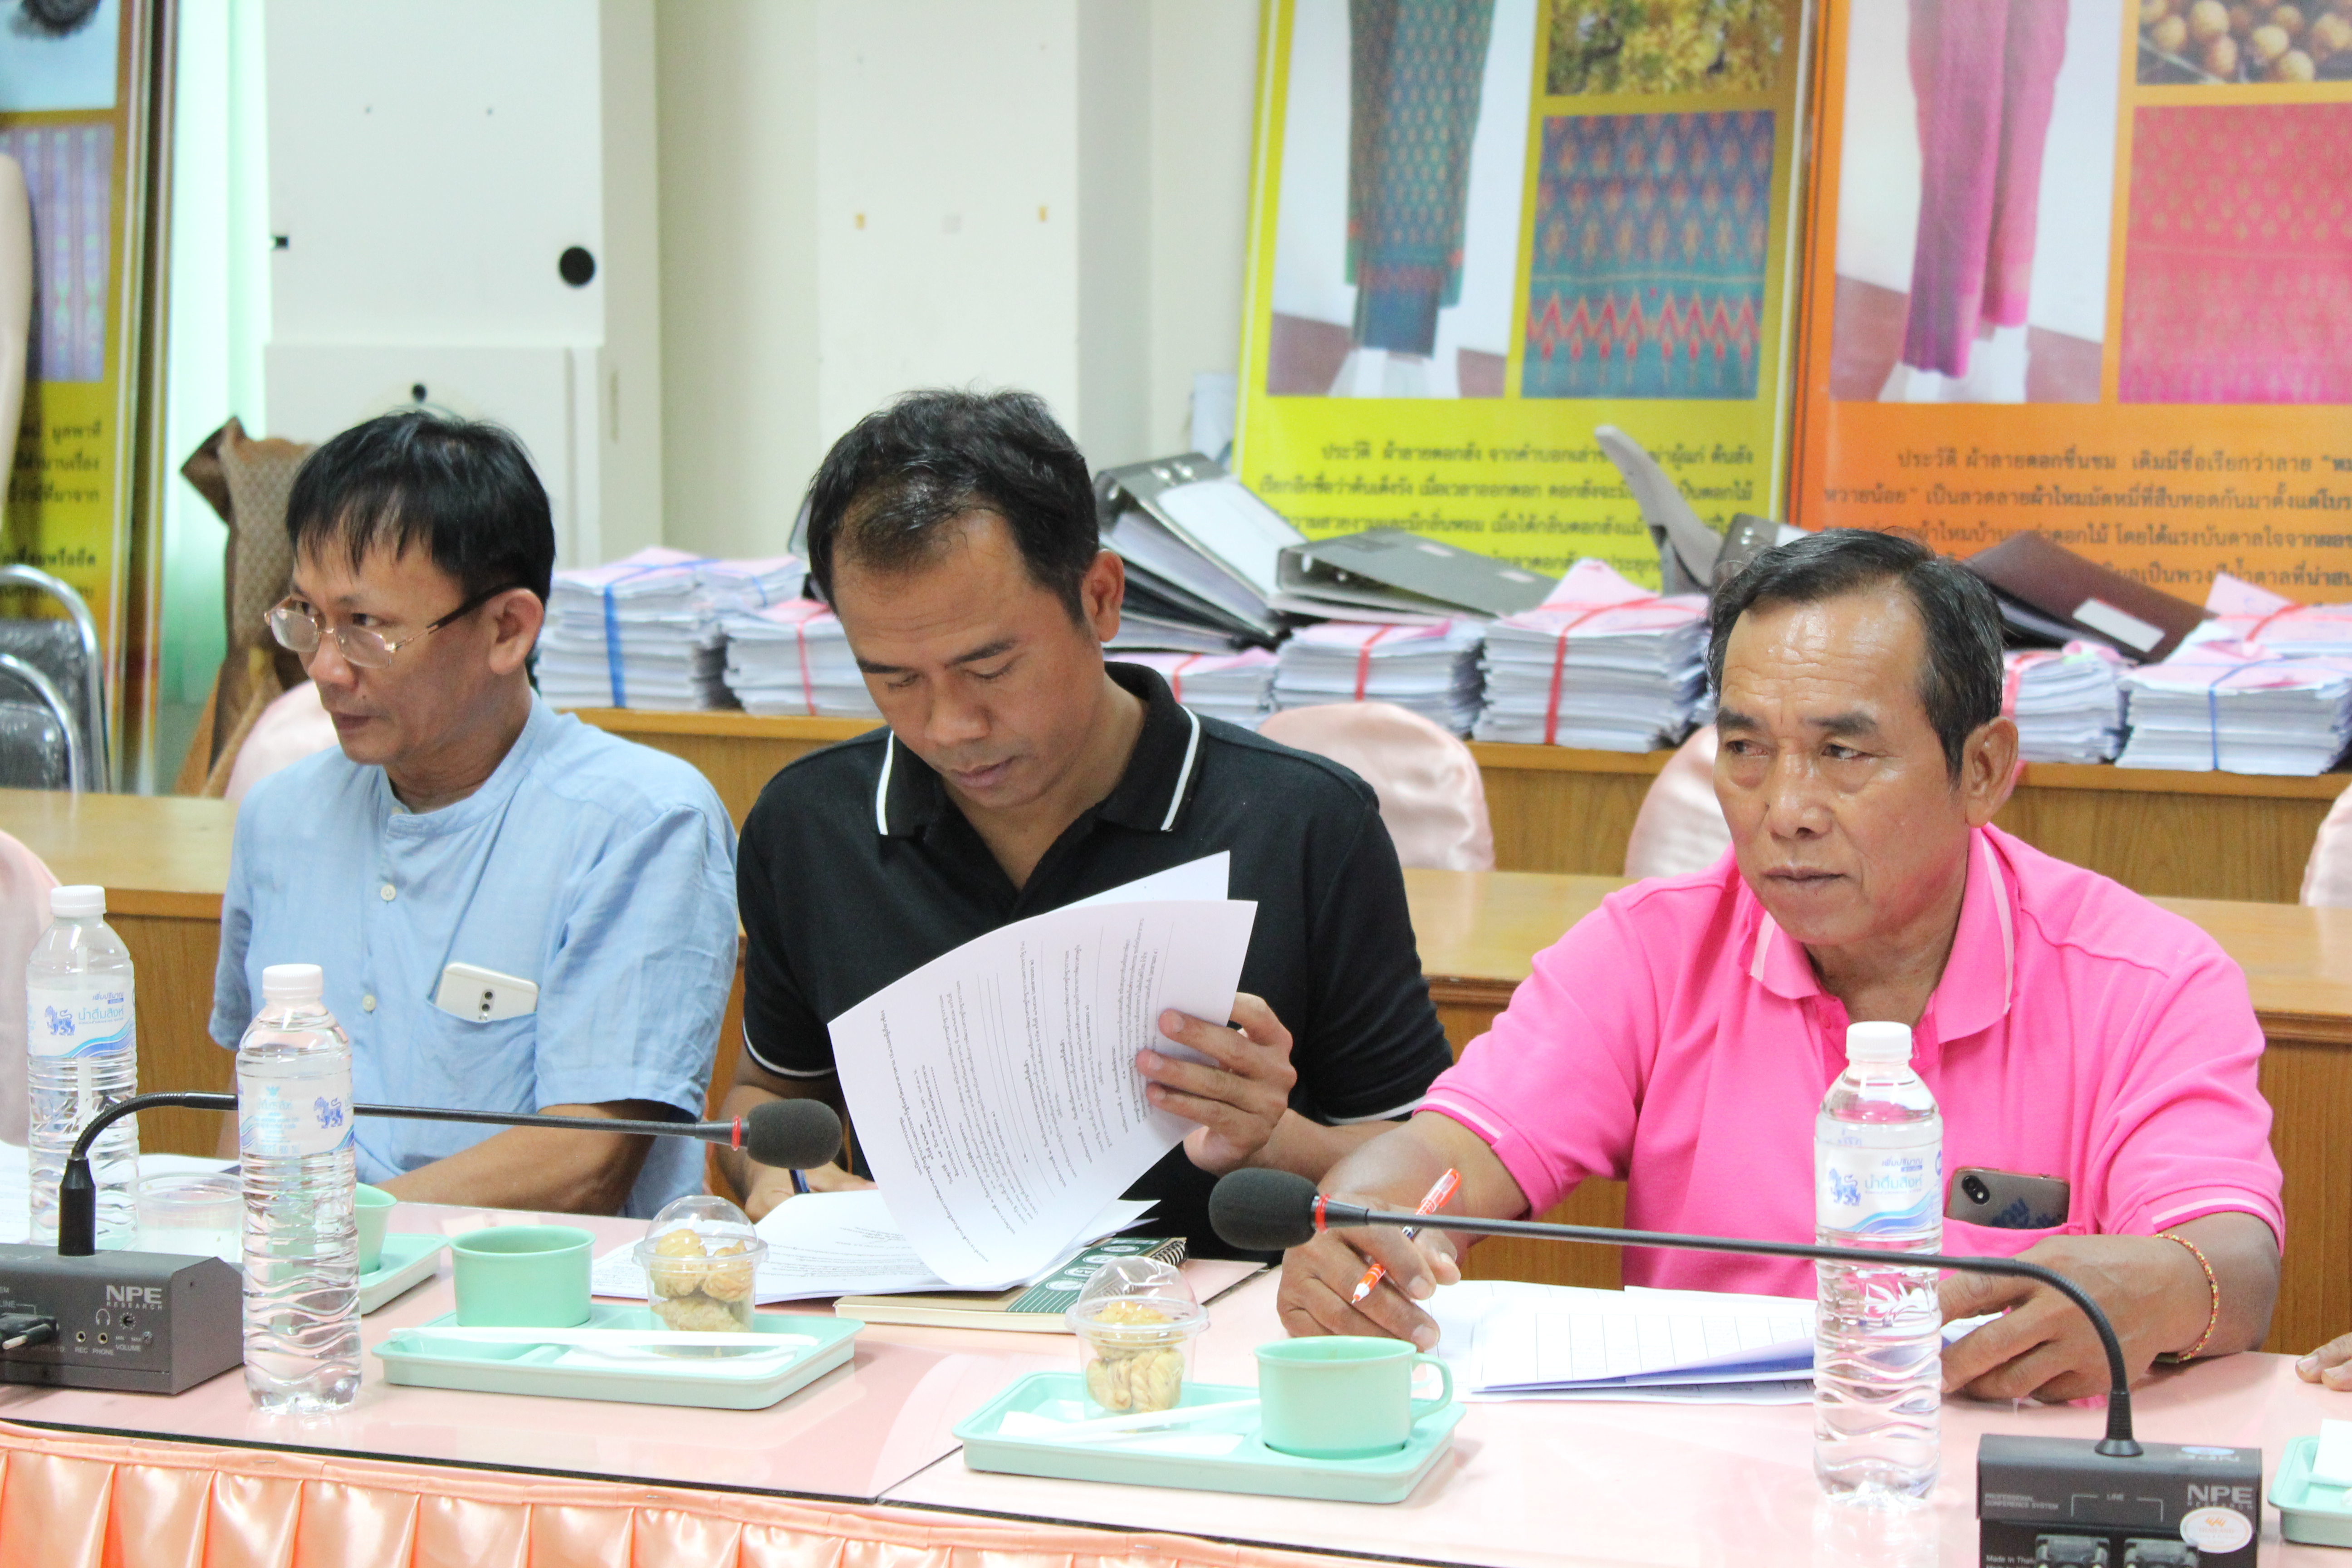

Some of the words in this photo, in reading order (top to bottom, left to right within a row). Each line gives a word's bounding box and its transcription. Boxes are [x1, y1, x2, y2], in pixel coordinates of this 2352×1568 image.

[1322, 443, 1371, 461] ประวัติ
[1898, 447, 1957, 469] ประวัติ
[1966, 445, 2117, 470] ผ้าลายดอกชื่นชม
[2132, 446, 2312, 472] เดิมมีชื่อเรียกว่าลาย
[78, 1005, 124, 1020] น้ำดื่มสิงห์
[921, 1064, 944, 1135] ศาลากลางจังหวัดมหาสารคาม
[899, 1116, 922, 1176] ระเบียบวาระการประชุม
[930, 1129, 939, 1148] มีนาคม
[925, 1146, 934, 1160] ครั้งที่
[946, 1149, 960, 1177] ห้องประชุม
[941, 1163, 953, 1185] วันศุกร์ที่
[1865, 1174, 1923, 1189] น้ำดื่มสิงห์
[1015, 1193, 1027, 1212] มกราคม
[991, 1204, 1015, 1235] ระเบียบวาระที่
[106, 1284, 162, 1304] NPE
[106, 1301, 163, 1310] RESEARCH
[92, 1348, 114, 1356] PHONE
[115, 1344, 142, 1352] VOLUME
[2106, 1493, 2125, 1501] LINE
[2187, 1484, 2253, 1504] NPE
[1985, 1554, 2006, 1563] Made
